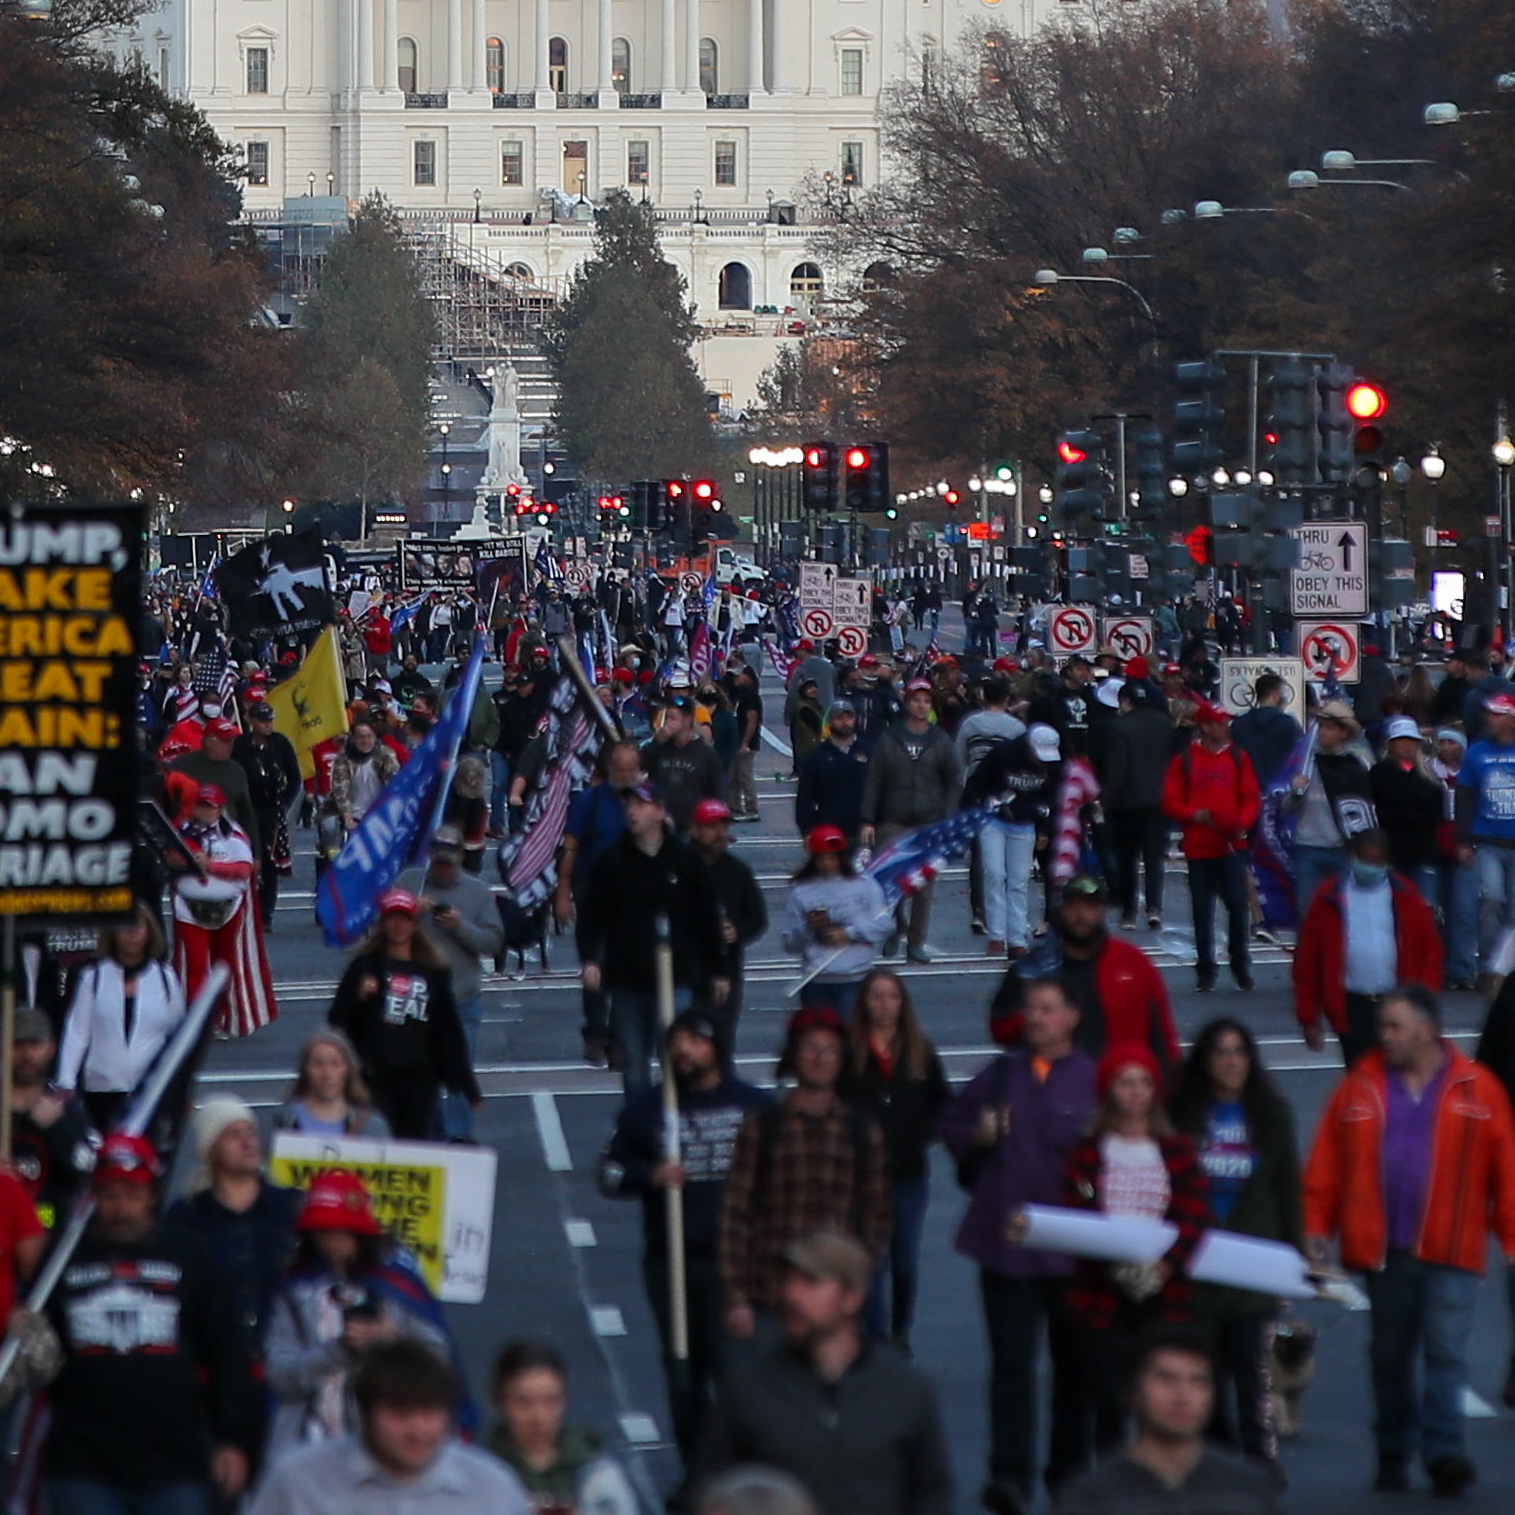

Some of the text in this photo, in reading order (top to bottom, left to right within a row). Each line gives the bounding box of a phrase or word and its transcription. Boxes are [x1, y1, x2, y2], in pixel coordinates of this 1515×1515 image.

[1296, 530, 1329, 544] THRU
[1296, 577, 1363, 591] OBEY THIS
[1296, 595, 1341, 609] SIGNAL
